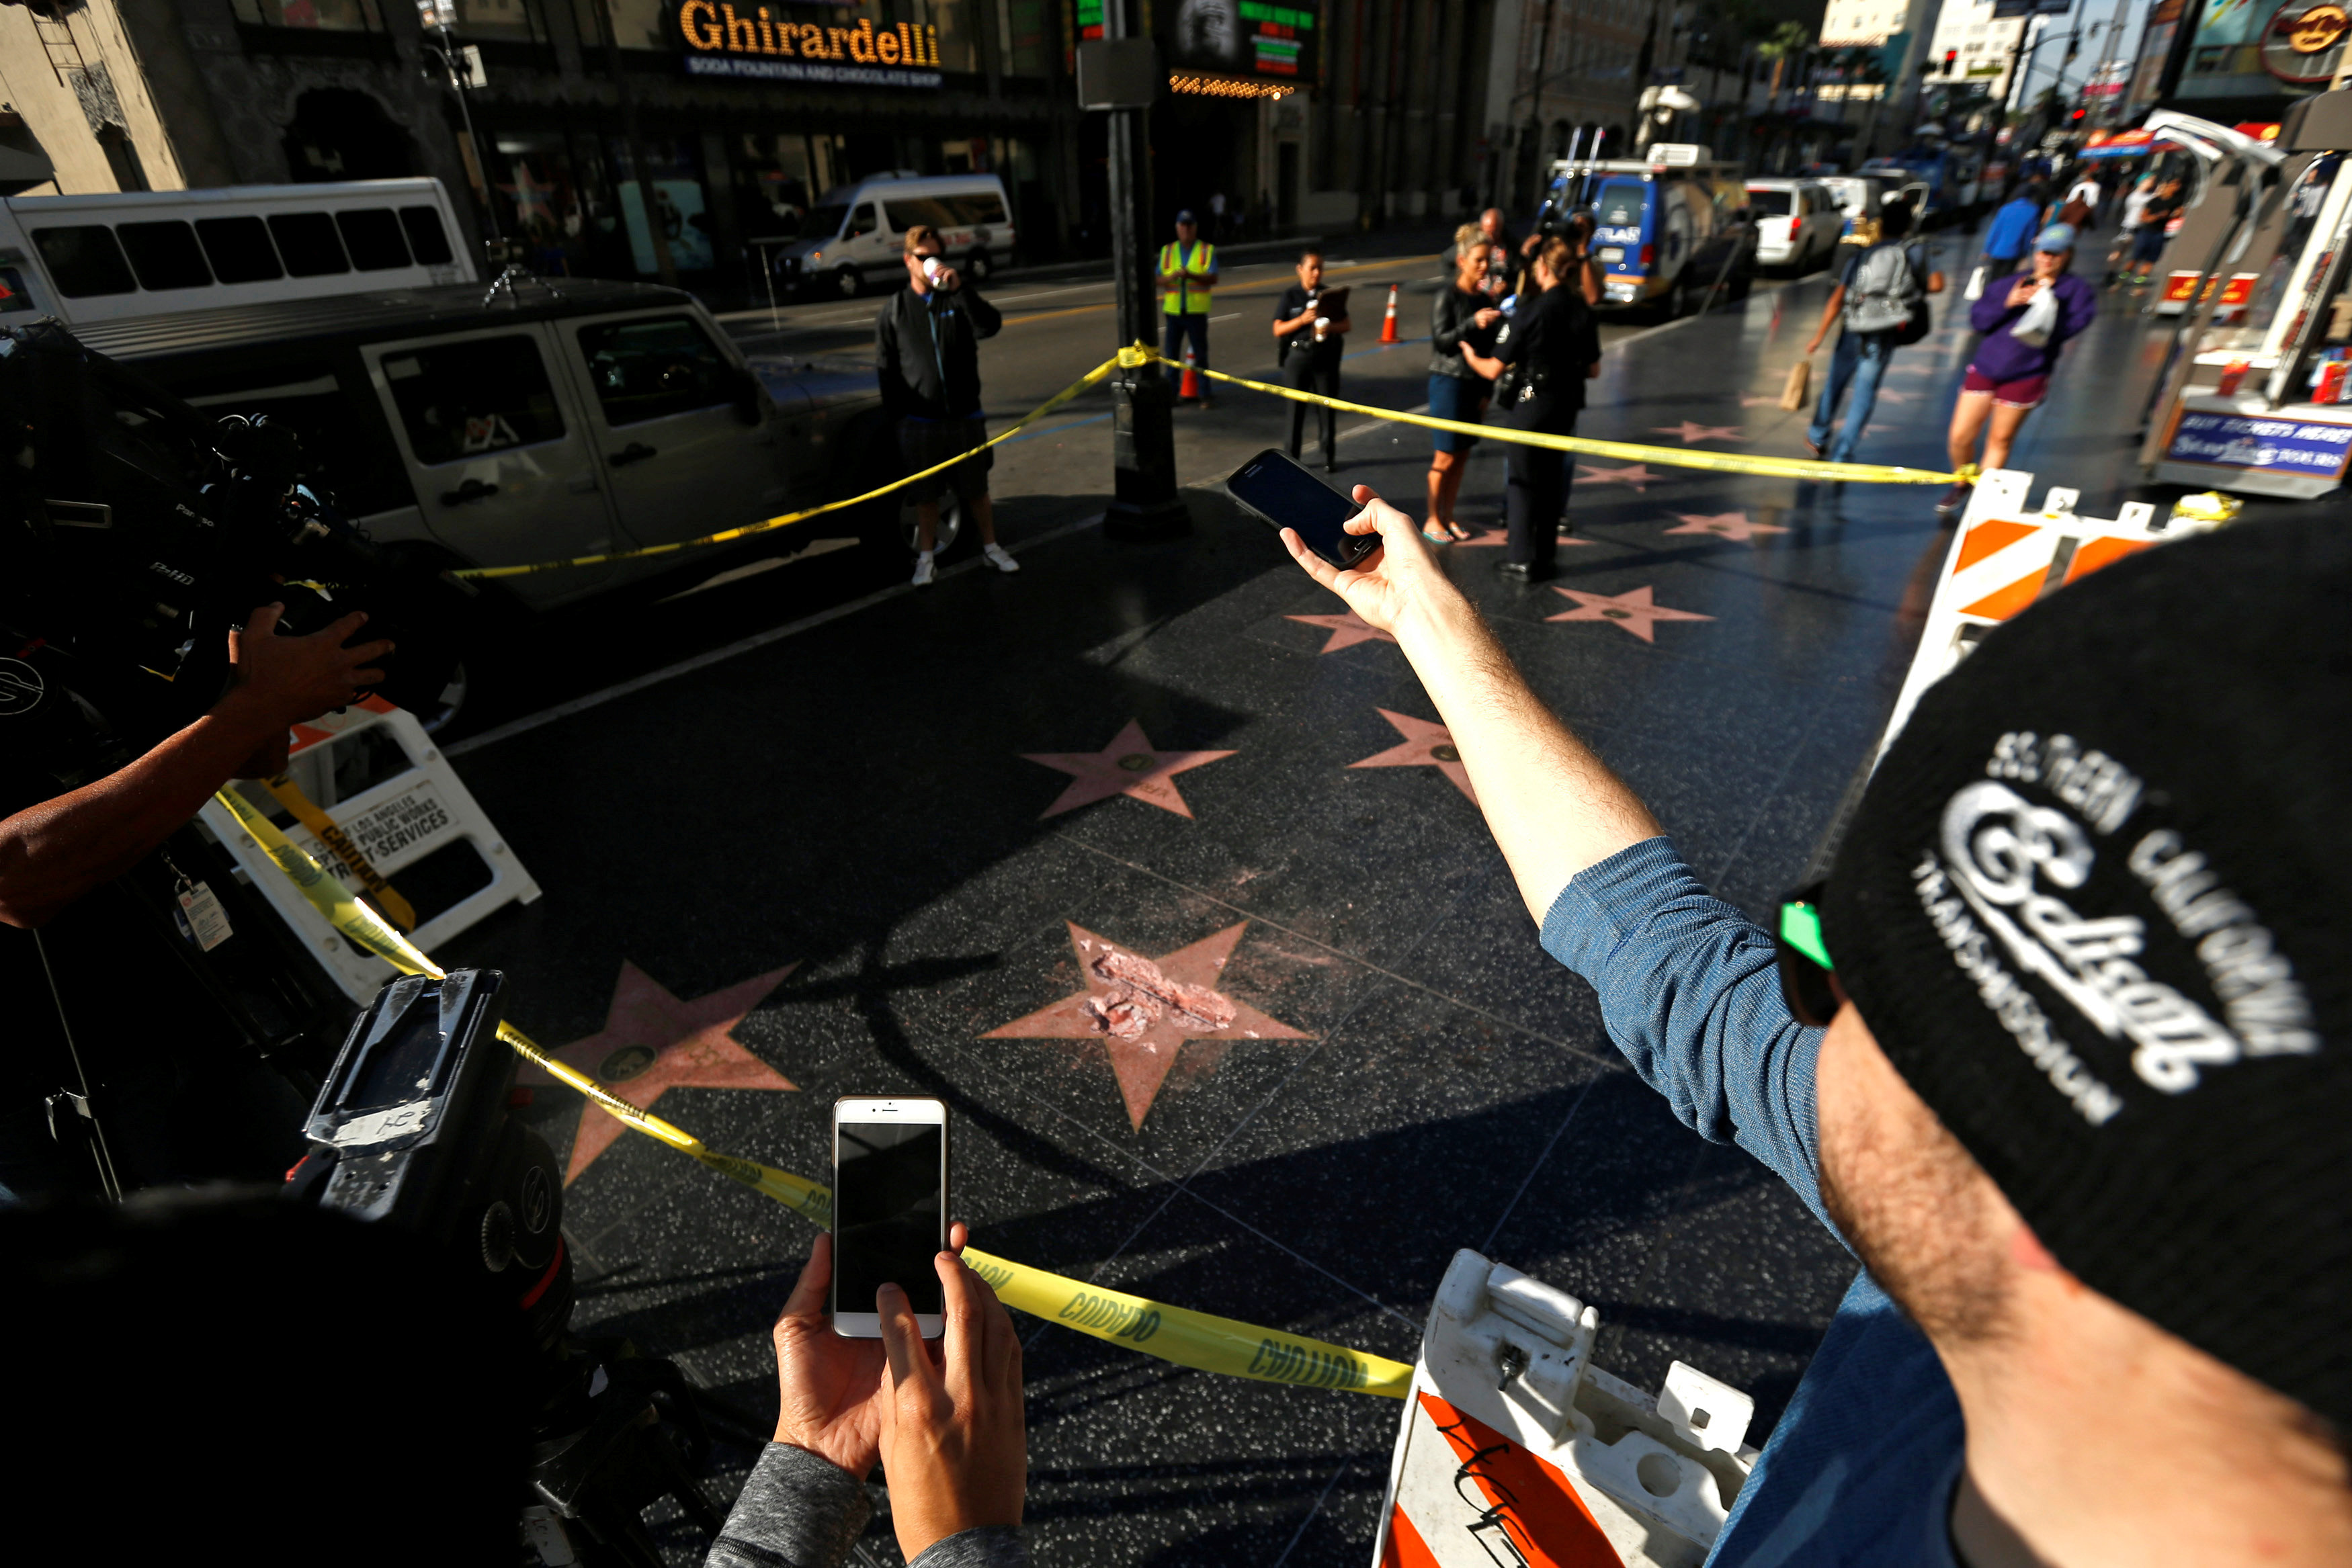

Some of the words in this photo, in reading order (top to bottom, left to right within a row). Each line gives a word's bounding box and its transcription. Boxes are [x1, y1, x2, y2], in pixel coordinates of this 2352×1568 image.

[679, 0, 940, 66] Ghirardelli
[689, 56, 731, 74] SODA
[733, 59, 804, 79] FOUNTAIN
[835, 67, 908, 85] CHOCOLATE
[352, 816, 373, 834] LOS
[373, 794, 416, 822] ANGELES
[358, 817, 400, 846] PUBLIC
[398, 797, 437, 825] WORKS
[377, 808, 450, 857] SERVICES
